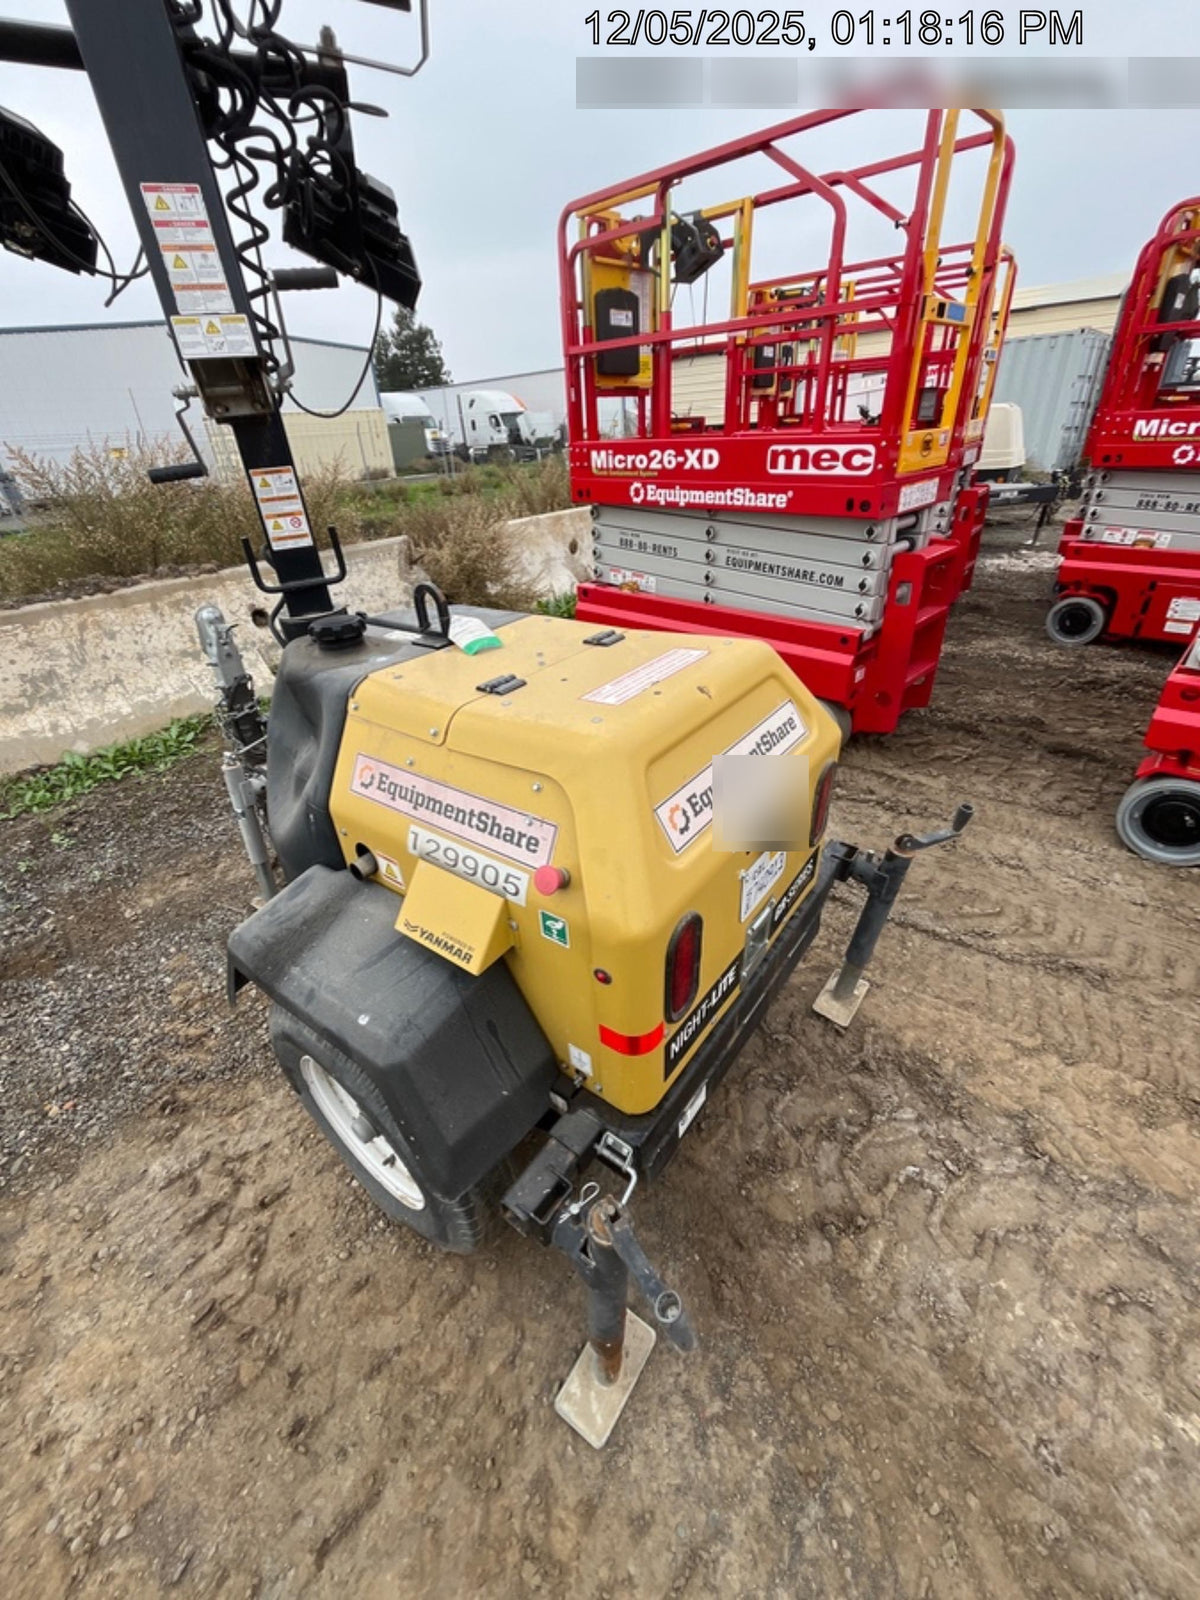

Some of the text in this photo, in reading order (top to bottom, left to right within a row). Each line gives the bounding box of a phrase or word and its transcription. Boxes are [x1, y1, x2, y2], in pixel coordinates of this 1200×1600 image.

[590, 448, 720, 471] Micro26-XD
[768, 447, 873, 471] mec
[645, 482, 788, 508] EquipmentShare
[725, 555, 845, 588] EQUIPMENTSHARE.COM
[376, 772, 541, 855] EquipmentShare
[410, 830, 523, 898] 129905
[418, 927, 474, 965] YANMAR
[669, 963, 740, 1060] NIGHT-LITE
